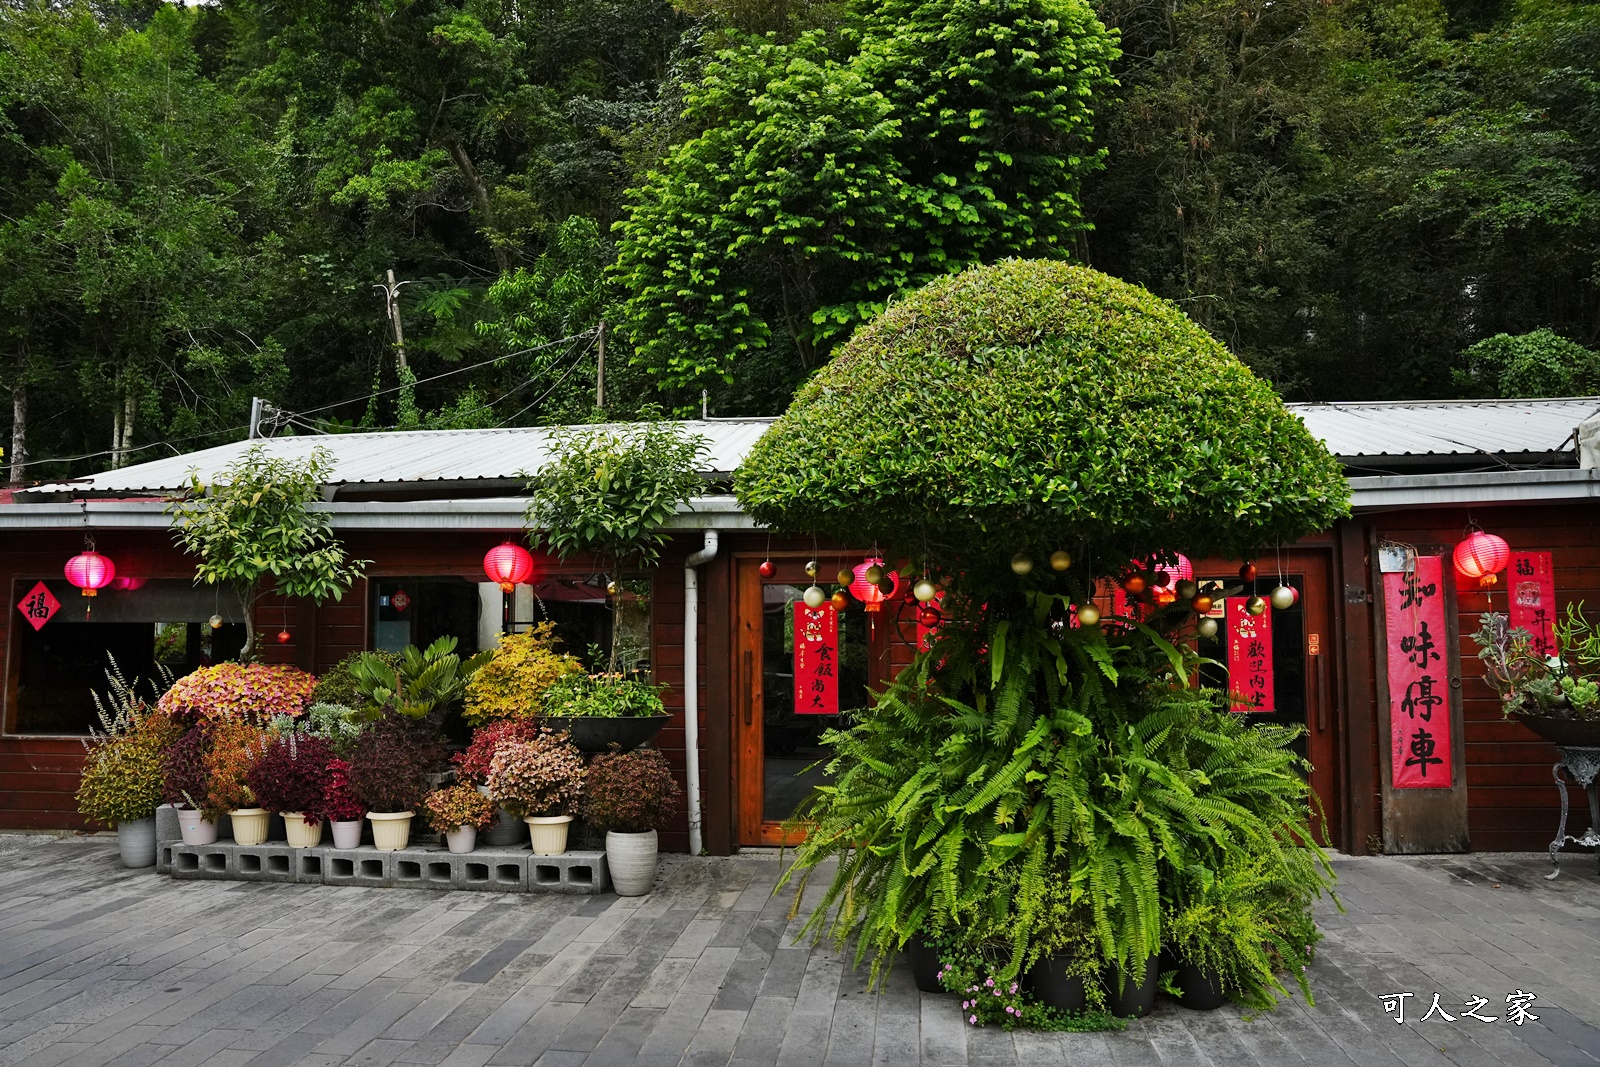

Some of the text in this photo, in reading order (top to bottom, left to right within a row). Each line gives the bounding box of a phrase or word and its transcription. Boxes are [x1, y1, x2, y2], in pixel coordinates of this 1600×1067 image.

[1515, 558, 1535, 576] 福
[26, 592, 50, 619] 福
[810, 642, 835, 709] 食飯尚大
[1246, 640, 1268, 707] 歡迎內坐
[1398, 572, 1443, 778] 知味停車
